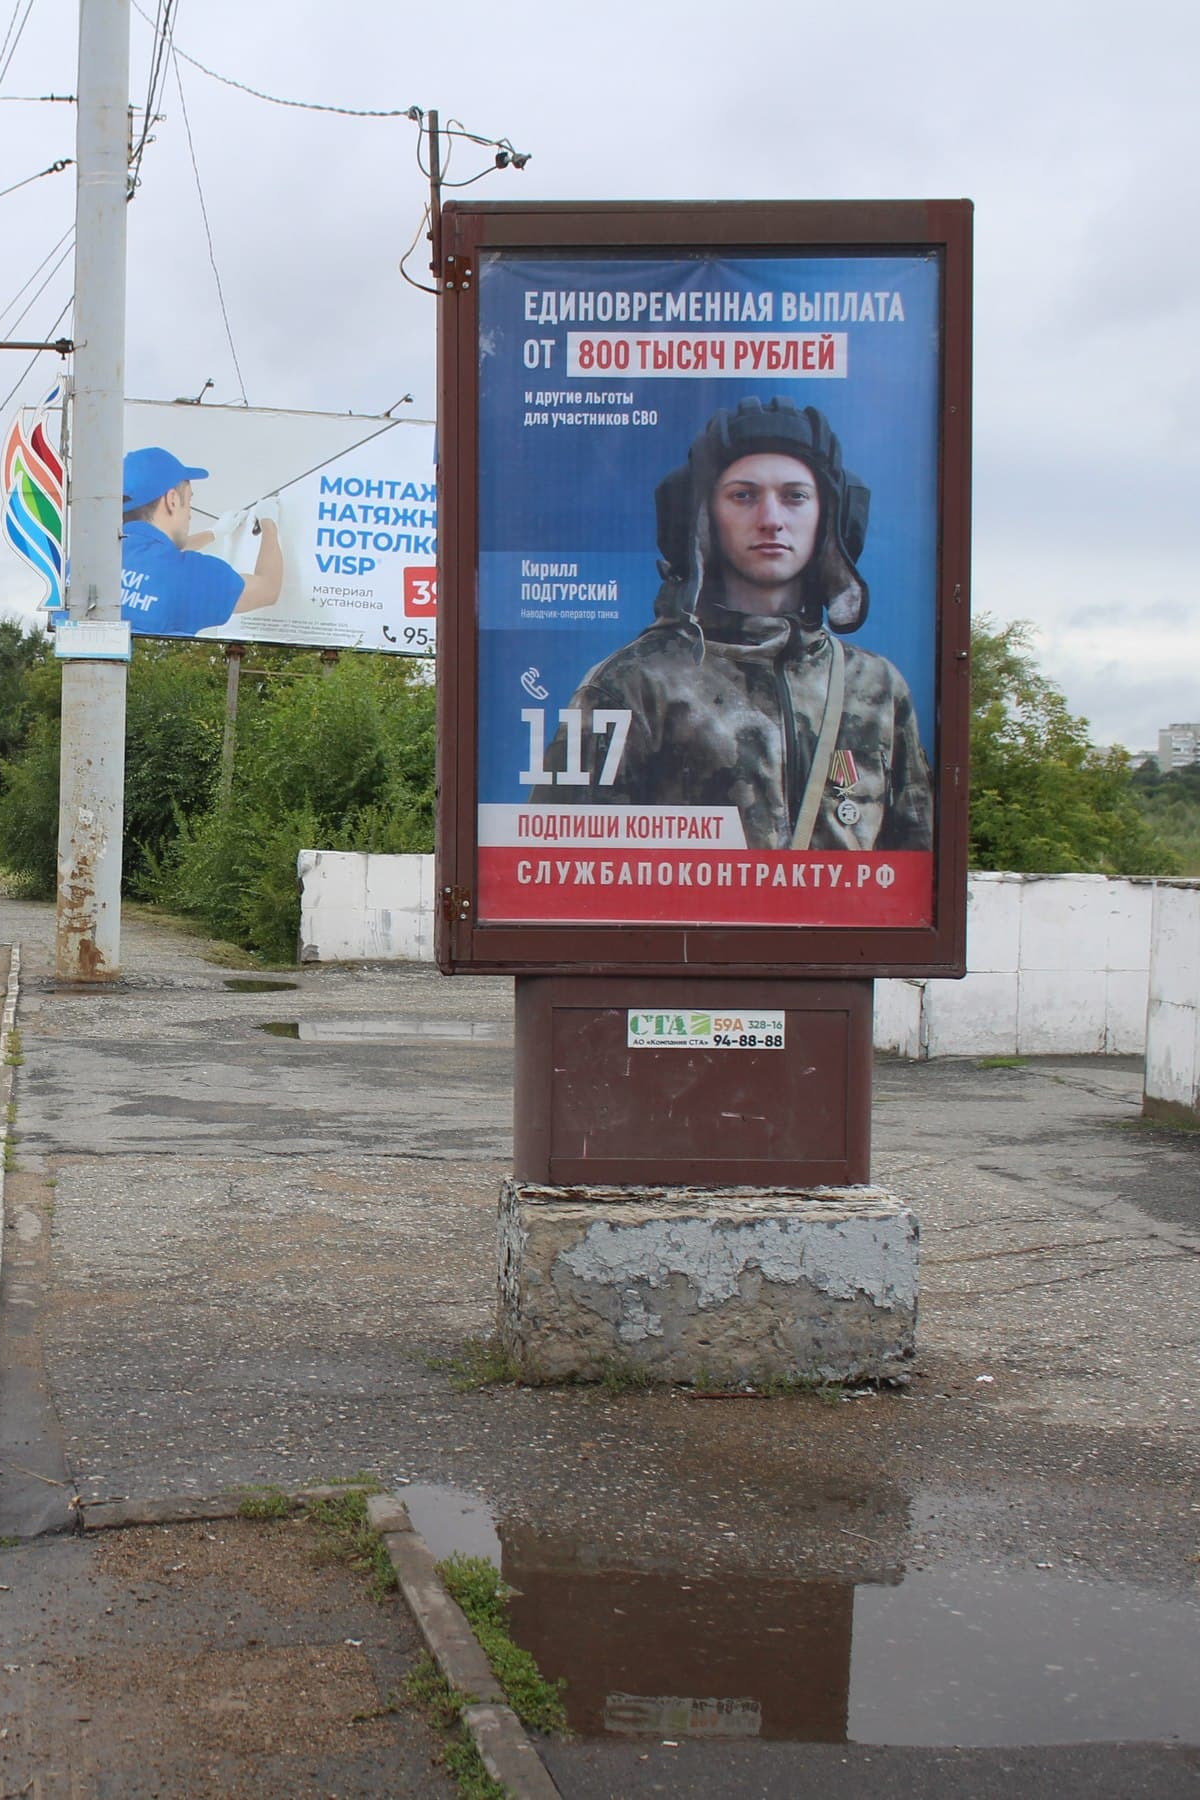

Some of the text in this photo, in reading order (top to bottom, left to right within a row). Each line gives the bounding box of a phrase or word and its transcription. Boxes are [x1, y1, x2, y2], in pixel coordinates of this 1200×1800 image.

[524, 291, 905, 325] ЕДИНОВРЕМЕННАЯ ВЫПЛАТА
[523, 333, 835, 371] ОТ 800 ТЫСЯЧ РУБЛЕЙ
[524, 391, 634, 407] и другие льготы
[523, 410, 658, 428] для участников СВО
[318, 501, 437, 529] НАТЯЖН
[316, 527, 437, 555] ПОТОЛК
[315, 553, 376, 576] VISP
[521, 559, 578, 581] Кирилл
[312, 585, 374, 598] материал
[521, 580, 618, 603] ПОДГУРСКИЙ
[319, 597, 384, 610] установка
[520, 608, 620, 621] Наводчик-оператор танка
[403, 626, 436, 646] 95-
[519, 708, 632, 786] 117
[517, 814, 724, 841] ПОДПИШИ КОНТРАКТ
[516, 860, 896, 889] СЛУЖБАПОКОНТРАКТУ.РФ
[630, 1014, 688, 1036] СТА
[713, 1018, 783, 1032] 59А 328-16
[633, 1038, 645, 1046] АО
[713, 1034, 783, 1048] 94-88-88
